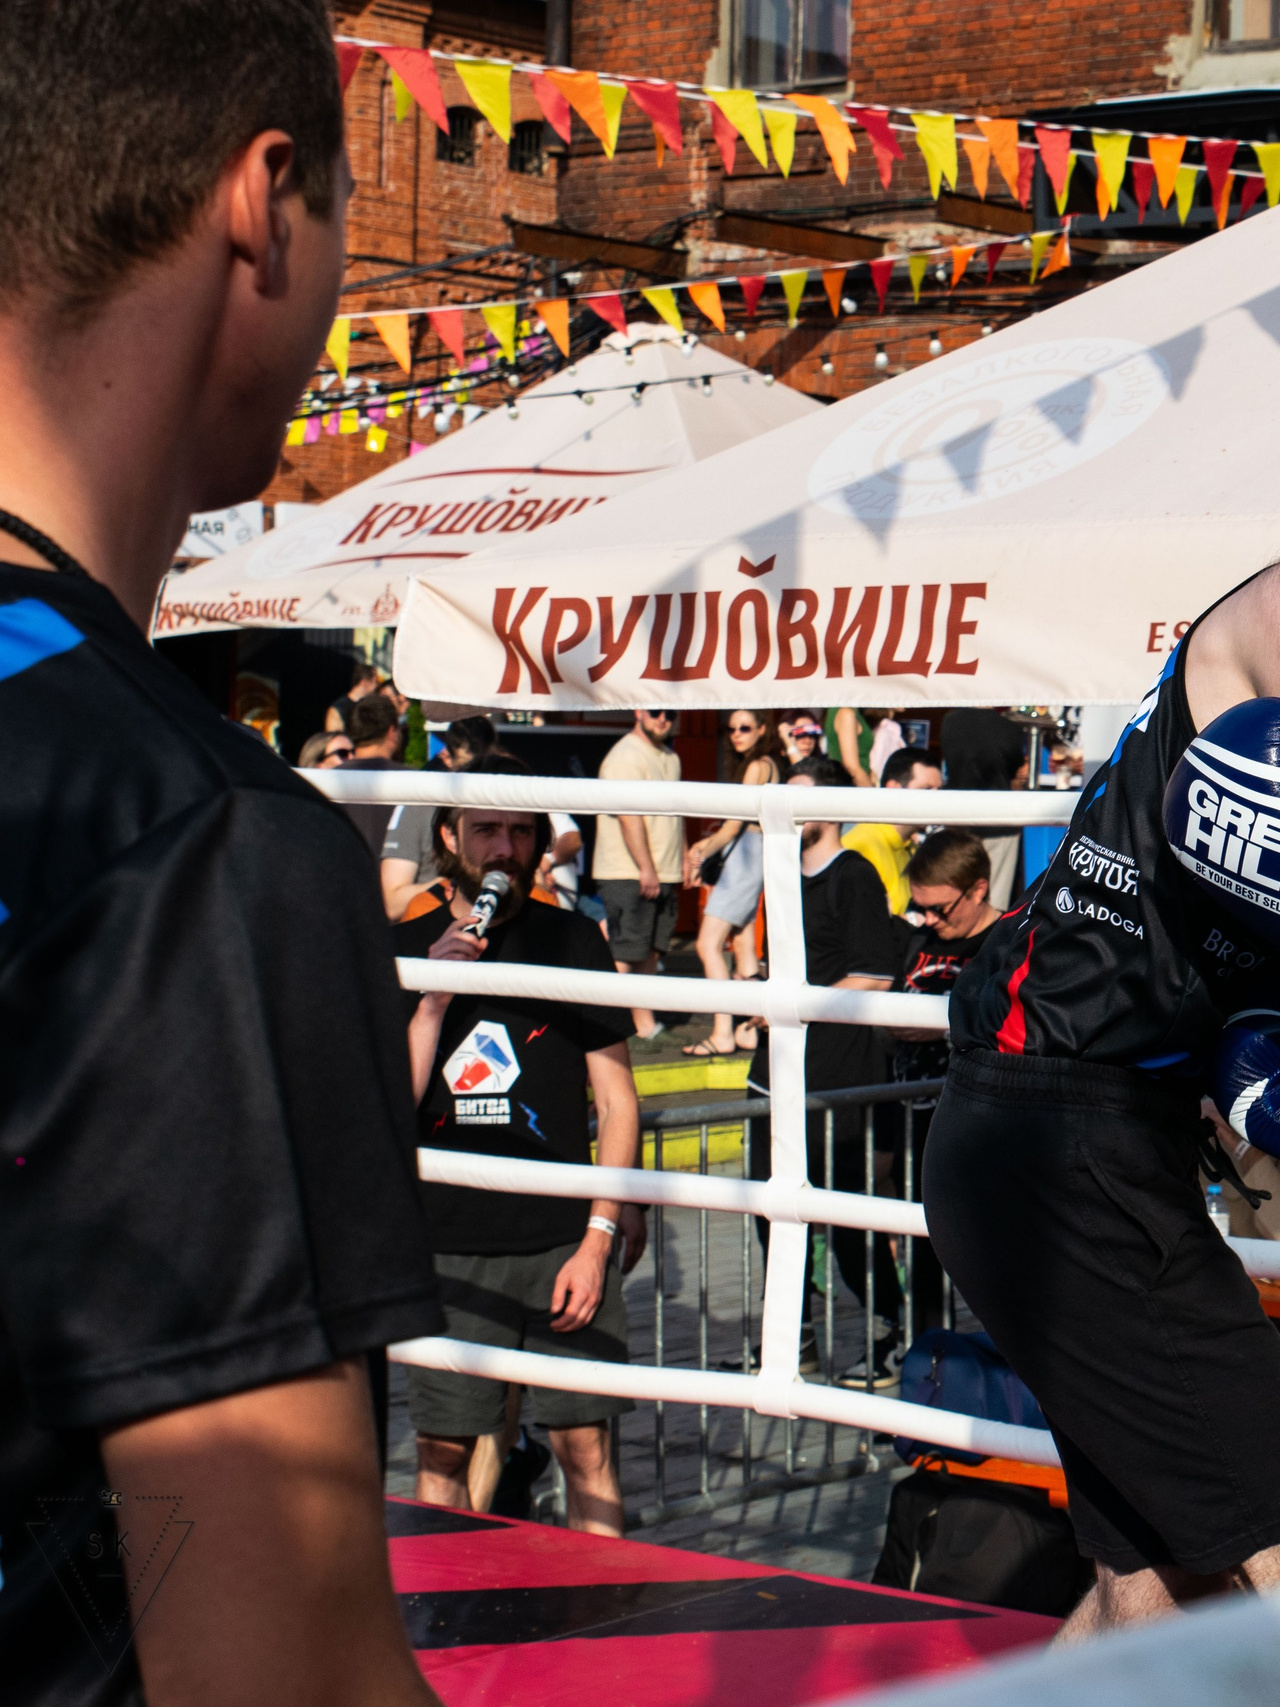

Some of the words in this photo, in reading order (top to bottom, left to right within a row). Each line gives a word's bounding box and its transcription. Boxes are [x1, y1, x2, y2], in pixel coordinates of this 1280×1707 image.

[1195, 862, 1207, 876] BE
[1208, 870, 1233, 891] YOUR
[1234, 883, 1261, 903] BEST
[1078, 900, 1144, 940] LADOGA
[455, 1098, 511, 1115] БИТВА
